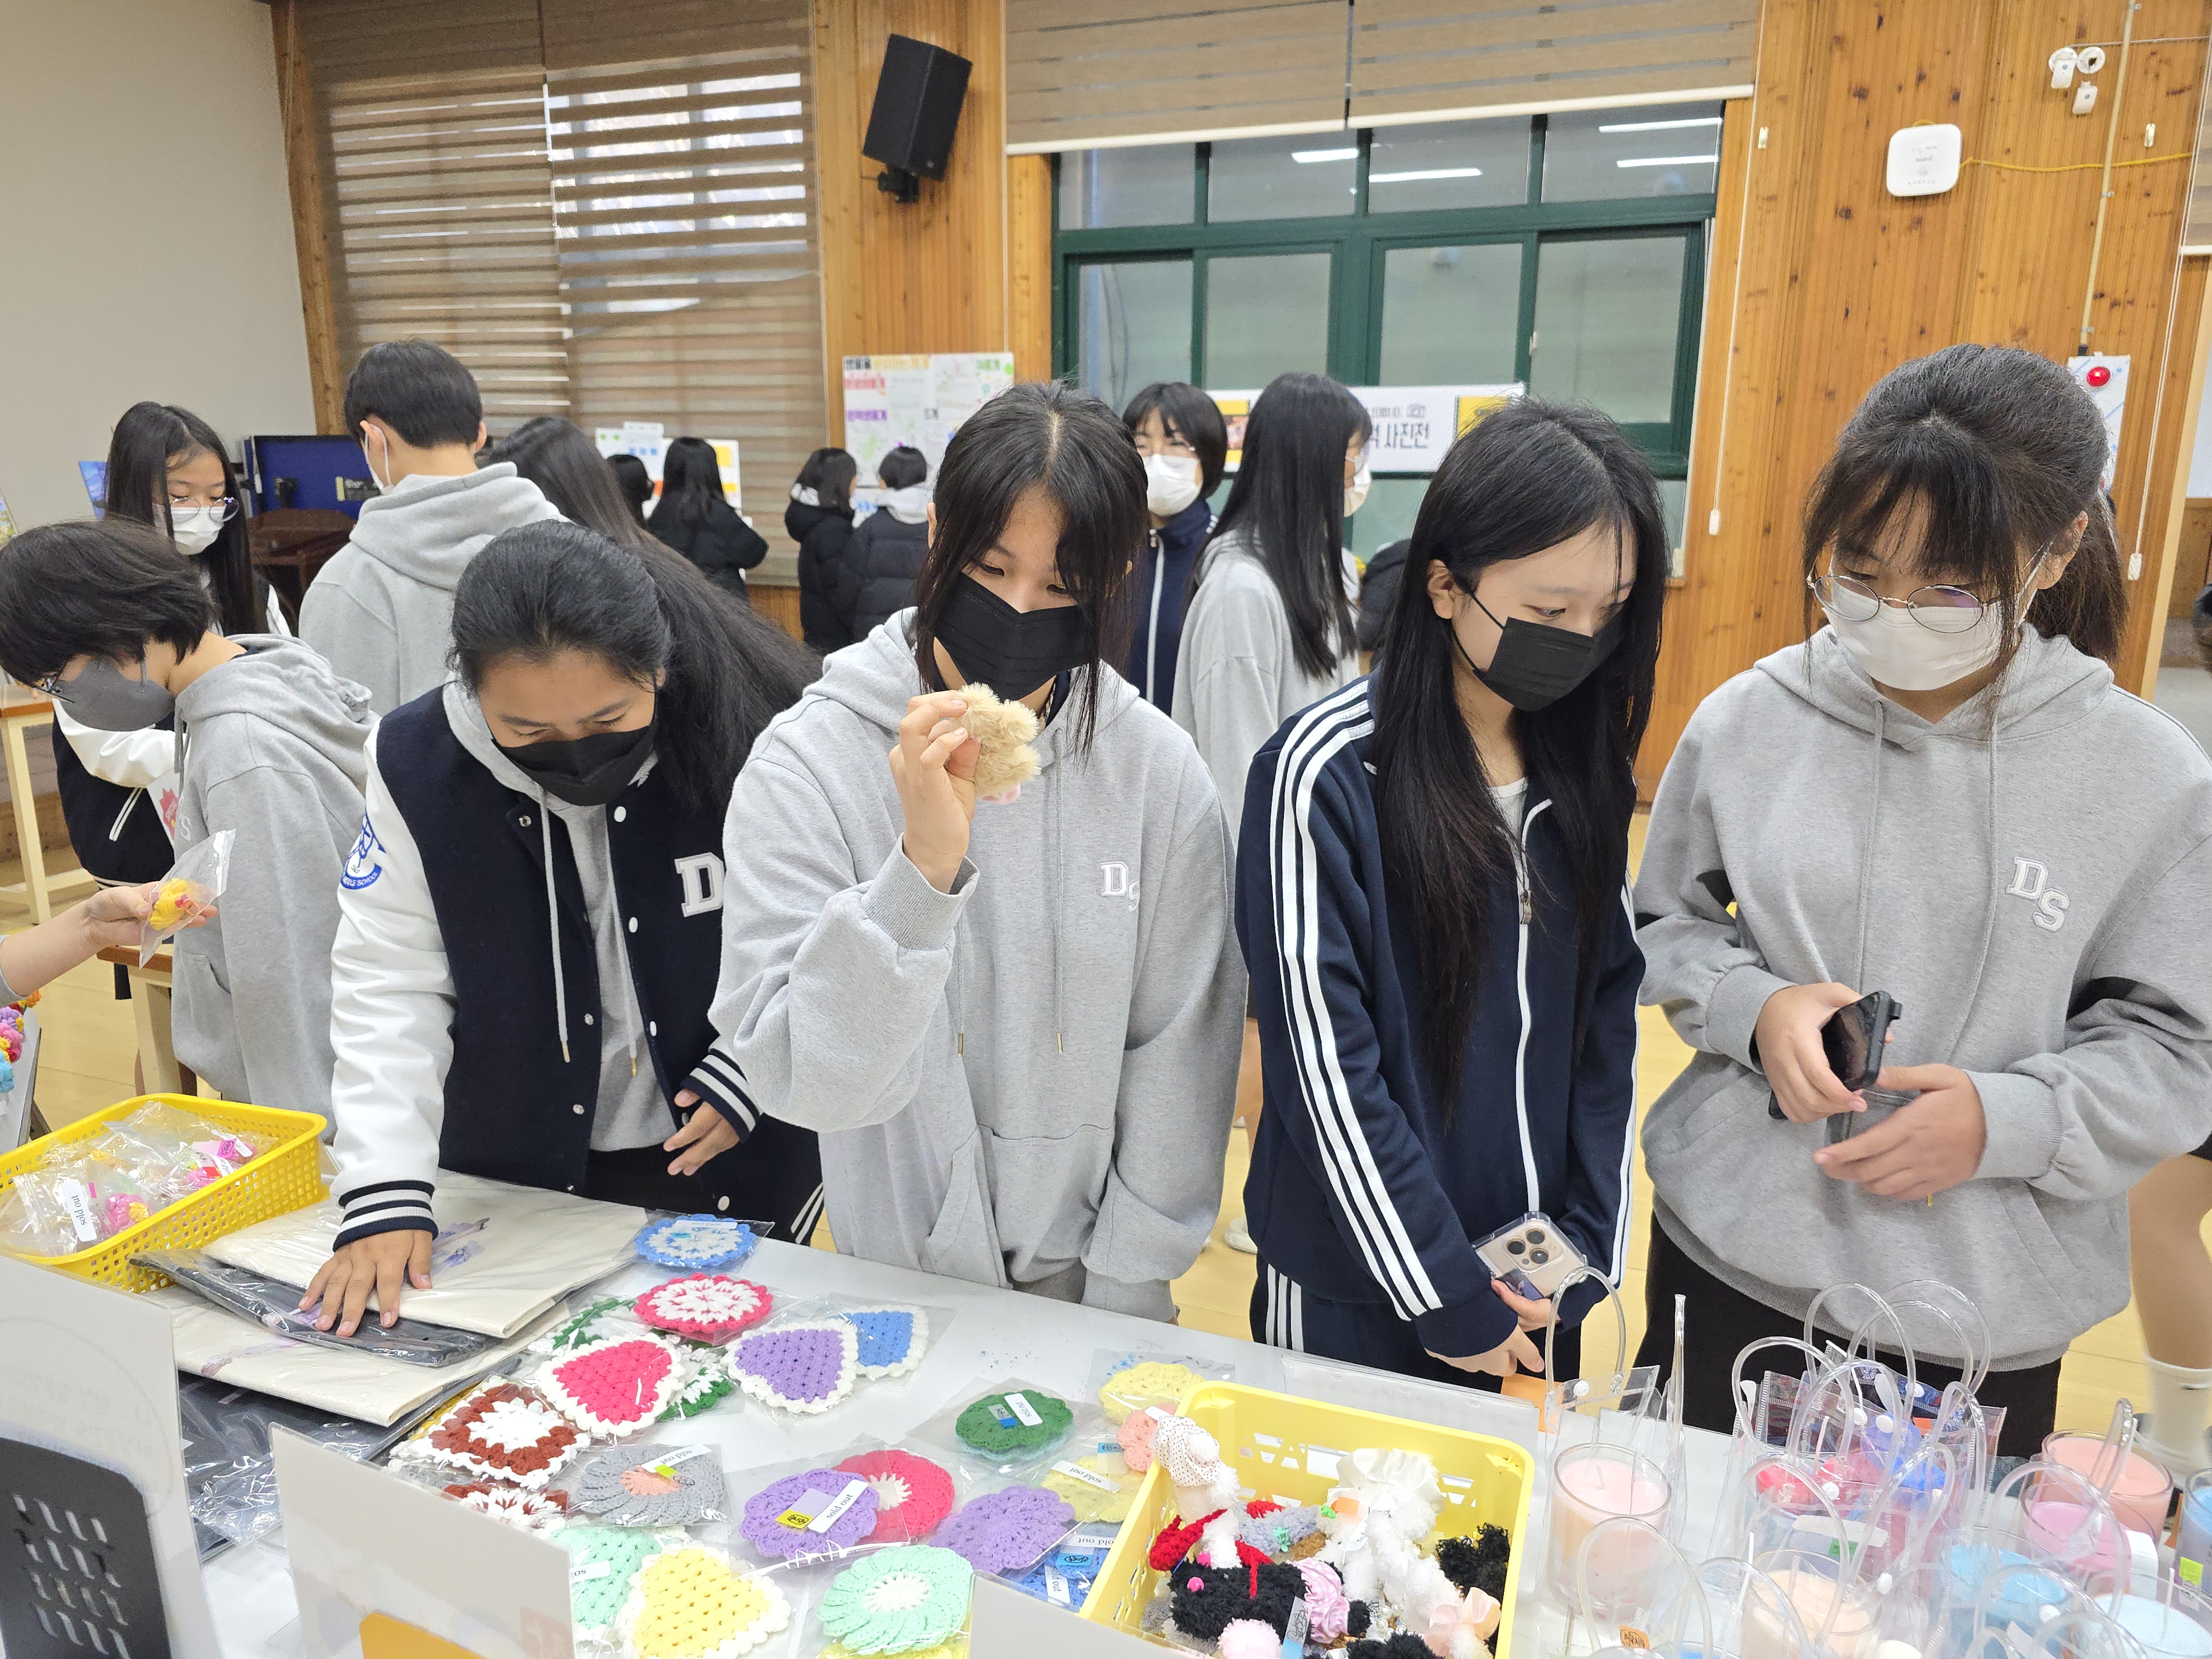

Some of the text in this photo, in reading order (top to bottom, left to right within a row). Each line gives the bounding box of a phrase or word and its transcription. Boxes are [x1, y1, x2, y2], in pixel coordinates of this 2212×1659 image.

[1384, 422, 1430, 448] 사진전
[2005, 857, 2070, 933] DS
[71, 1194, 87, 1225] sold out
[660, 1449, 692, 1464] sold out
[1083, 1473, 1103, 1483] sold
[826, 1494, 853, 1519] sold out
[1052, 1581, 1062, 1592] out
